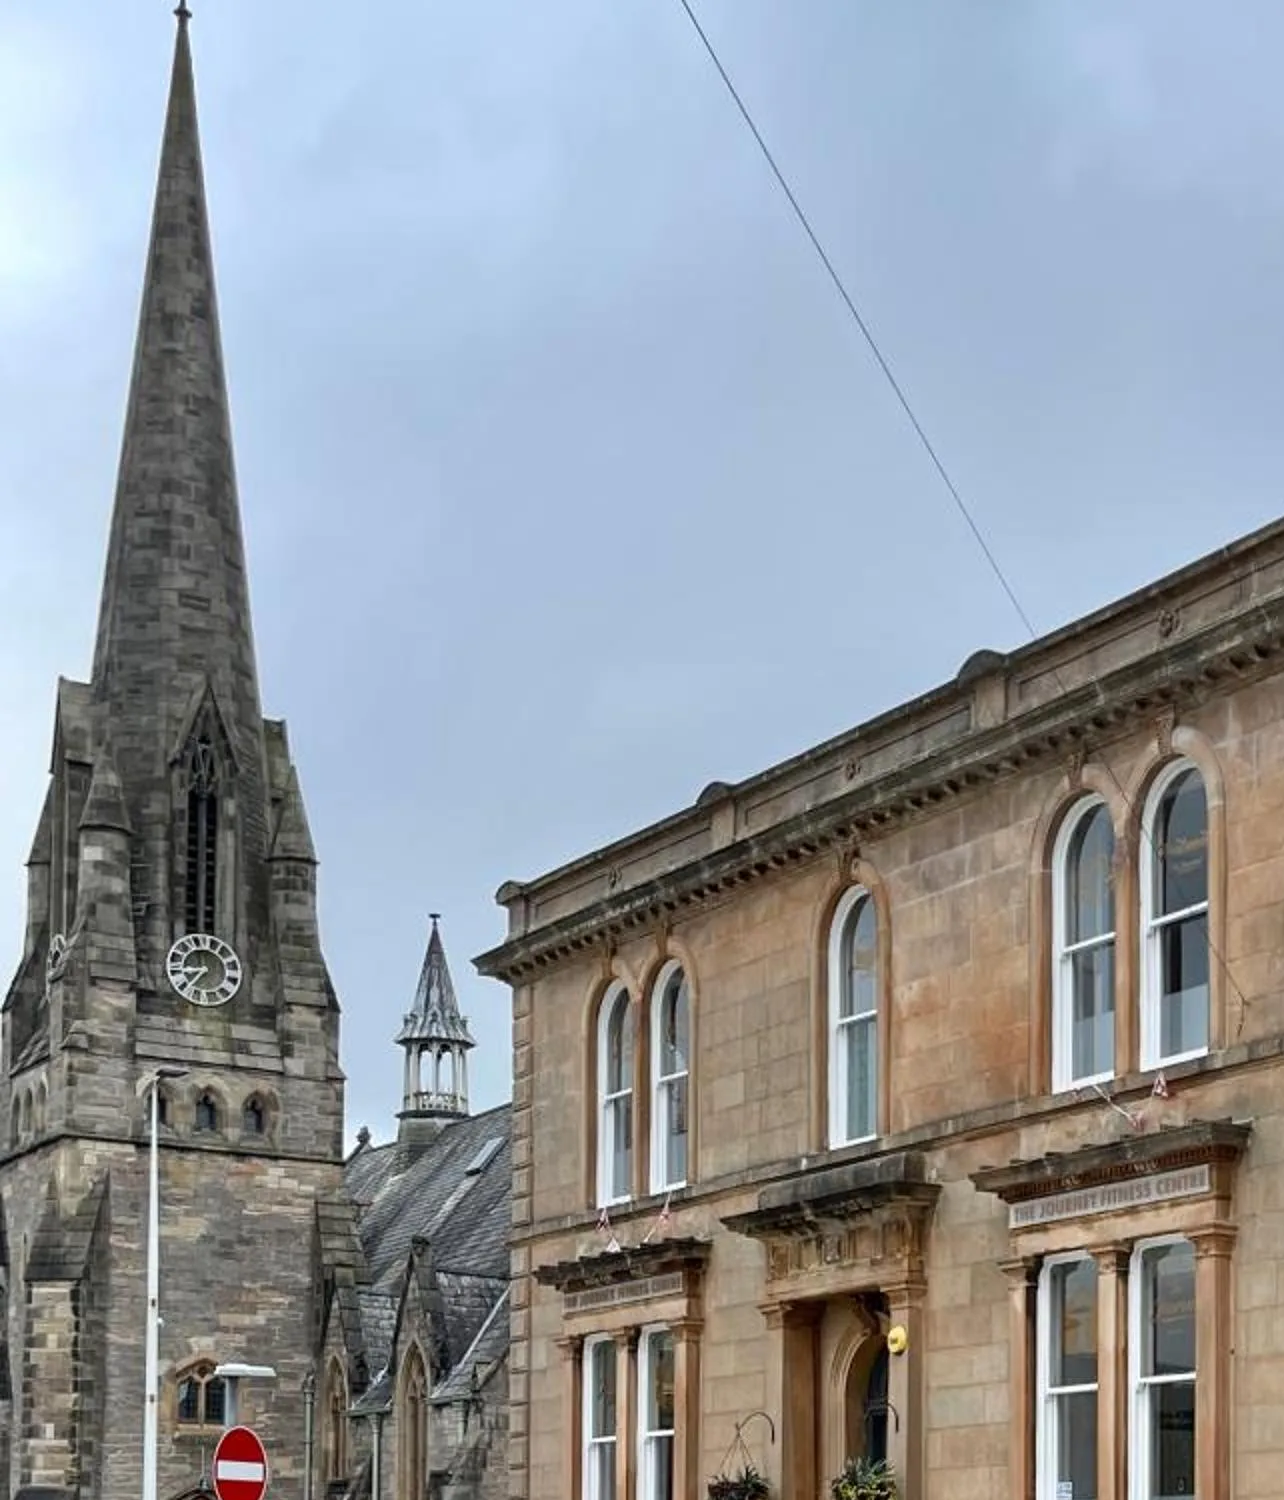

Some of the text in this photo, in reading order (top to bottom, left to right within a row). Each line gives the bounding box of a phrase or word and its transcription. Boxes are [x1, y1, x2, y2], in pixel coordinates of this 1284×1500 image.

[1015, 1167, 1206, 1222] THE JOURNEY FITNESS CENTRE
